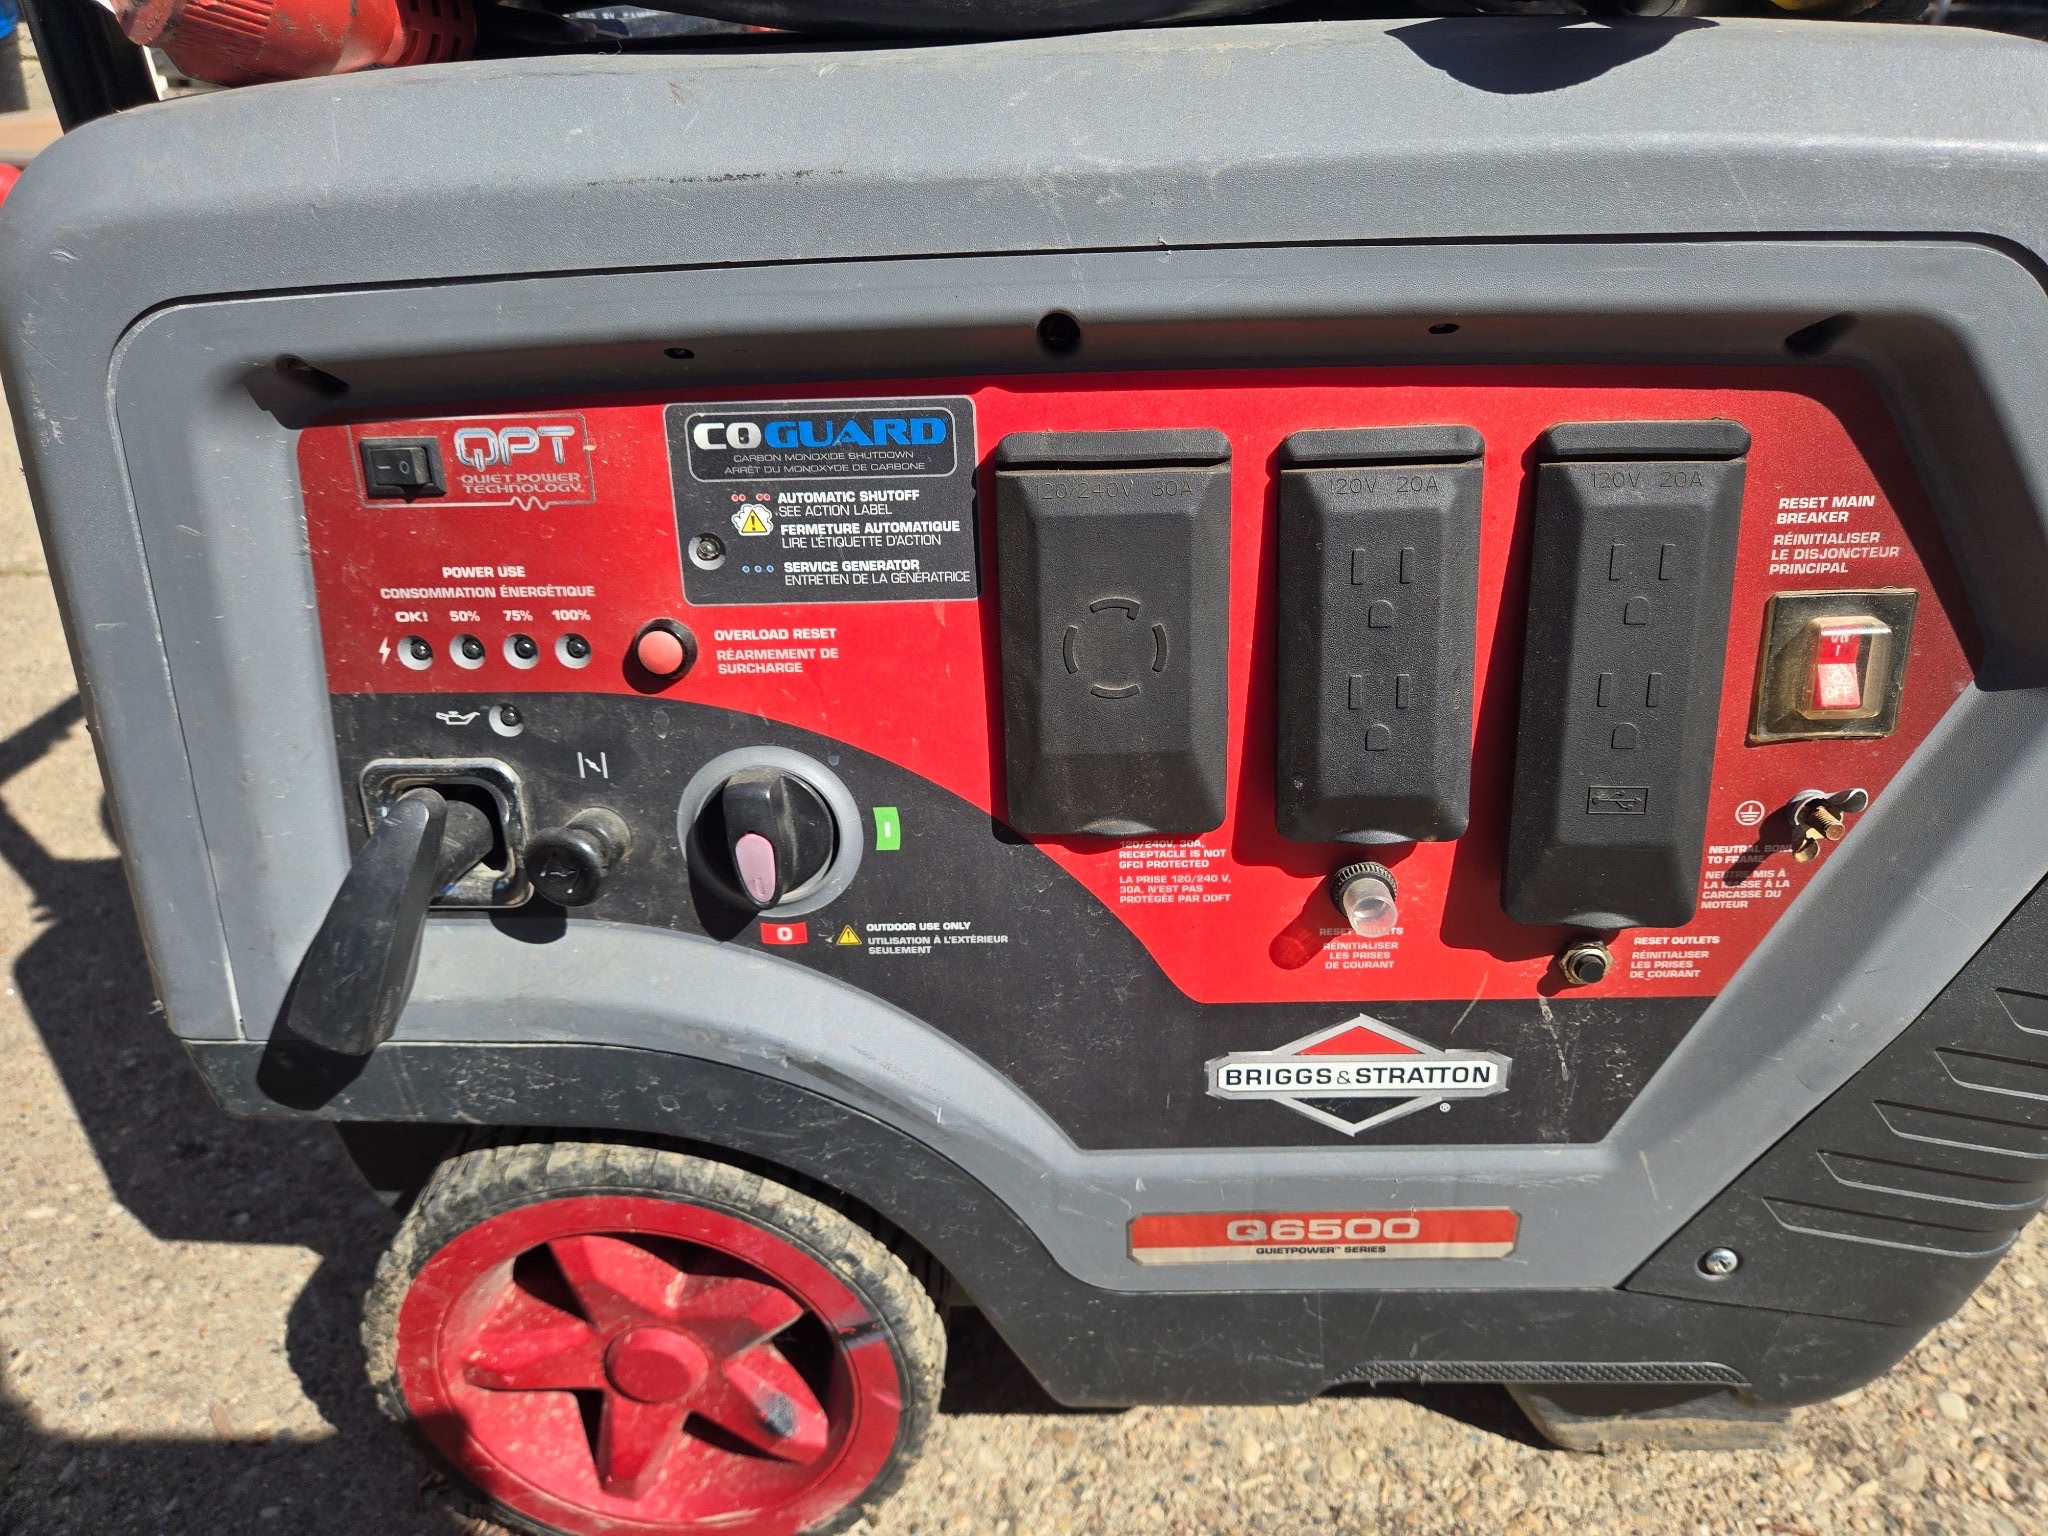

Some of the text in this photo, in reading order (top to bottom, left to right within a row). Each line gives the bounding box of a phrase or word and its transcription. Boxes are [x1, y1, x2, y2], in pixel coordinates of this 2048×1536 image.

[733, 450, 914, 463] CARBON MONOXIDE SHUTDOWN
[724, 462, 926, 475] ARRÊT DU MONOXYDE DE CARBONE
[460, 472, 580, 484] QUIET POWER
[1592, 470, 1703, 489] 120V 20A
[1328, 475, 1439, 495] 120V 20A
[778, 489, 920, 504] AUTOMATIC SHUTOFF
[1779, 495, 1875, 510] RESET MAIN
[778, 503, 893, 517] SEE ACTION LABEL
[1776, 511, 1849, 525] BREAKER
[781, 520, 960, 536] FERMETURE AUTOMATIQUE
[781, 533, 941, 549] LIRE L'ÉTIQUETTE D'ACTION
[1773, 531, 1880, 546] RÉINITIALISER
[1771, 546, 1900, 561] LE DISJONCTEUR
[442, 565, 526, 578] POWER USE
[784, 559, 920, 573] SERVICE GENERATOR
[1769, 562, 1848, 575] PRINCIPAL
[785, 569, 970, 586] ENTRETIEN DE LA GÉNÉRATRICE
[380, 584, 595, 599] CONSOMMATION ÉNERGÉTIQUE
[395, 609, 591, 622] OK! 50% 75% 100%
[714, 627, 837, 641] OVERLOAD RESET
[716, 648, 839, 661] RÉARMEMENT DE
[718, 662, 803, 674] SURCHARGE
[1119, 849, 1226, 858] RECEPTACLE IS NOT
[1708, 844, 1793, 854] NEUTRAL BON
[1119, 859, 1209, 869] GFCI PROTECTED
[1707, 855, 1765, 864] TO FRAME
[1120, 875, 1133, 884] LA
[1136, 875, 1167, 883] PRISE
[1171, 874, 1218, 883] 120/240
[1705, 867, 1786, 879] NEUTRE MIS À
[1120, 884, 1203, 894] 30A, N'EST PAS
[1703, 881, 1718, 889] LA
[1764, 878, 1773, 888] À
[1775, 879, 1790, 887] LA
[1120, 893, 1174, 903] PROTÉGÉE
[1178, 894, 1200, 903] PAR
[1702, 889, 1781, 899] CARCASSE DU
[1701, 900, 1748, 909] MOTEUR
[866, 922, 971, 932] OUTDOOR USE ONLY
[1319, 927, 1353, 936] RESET
[868, 934, 1008, 945] UTILISATION À L'EXTÉRIEUR
[1323, 940, 1399, 950] RÉINITIALISER
[1634, 935, 1720, 945] RESET OUTLETS
[868, 945, 932, 955] SEULEMENT
[1329, 951, 1390, 959] LES PRISES
[1632, 949, 1709, 959] RÉINITIALISER
[1325, 960, 1395, 969] DE COURANT
[1631, 960, 1693, 969] LES PRISES
[1629, 969, 1701, 978] DE COURANT
[1226, 1217, 1420, 1242] Q6500
[1344, 1245, 1386, 1254] SERIES
